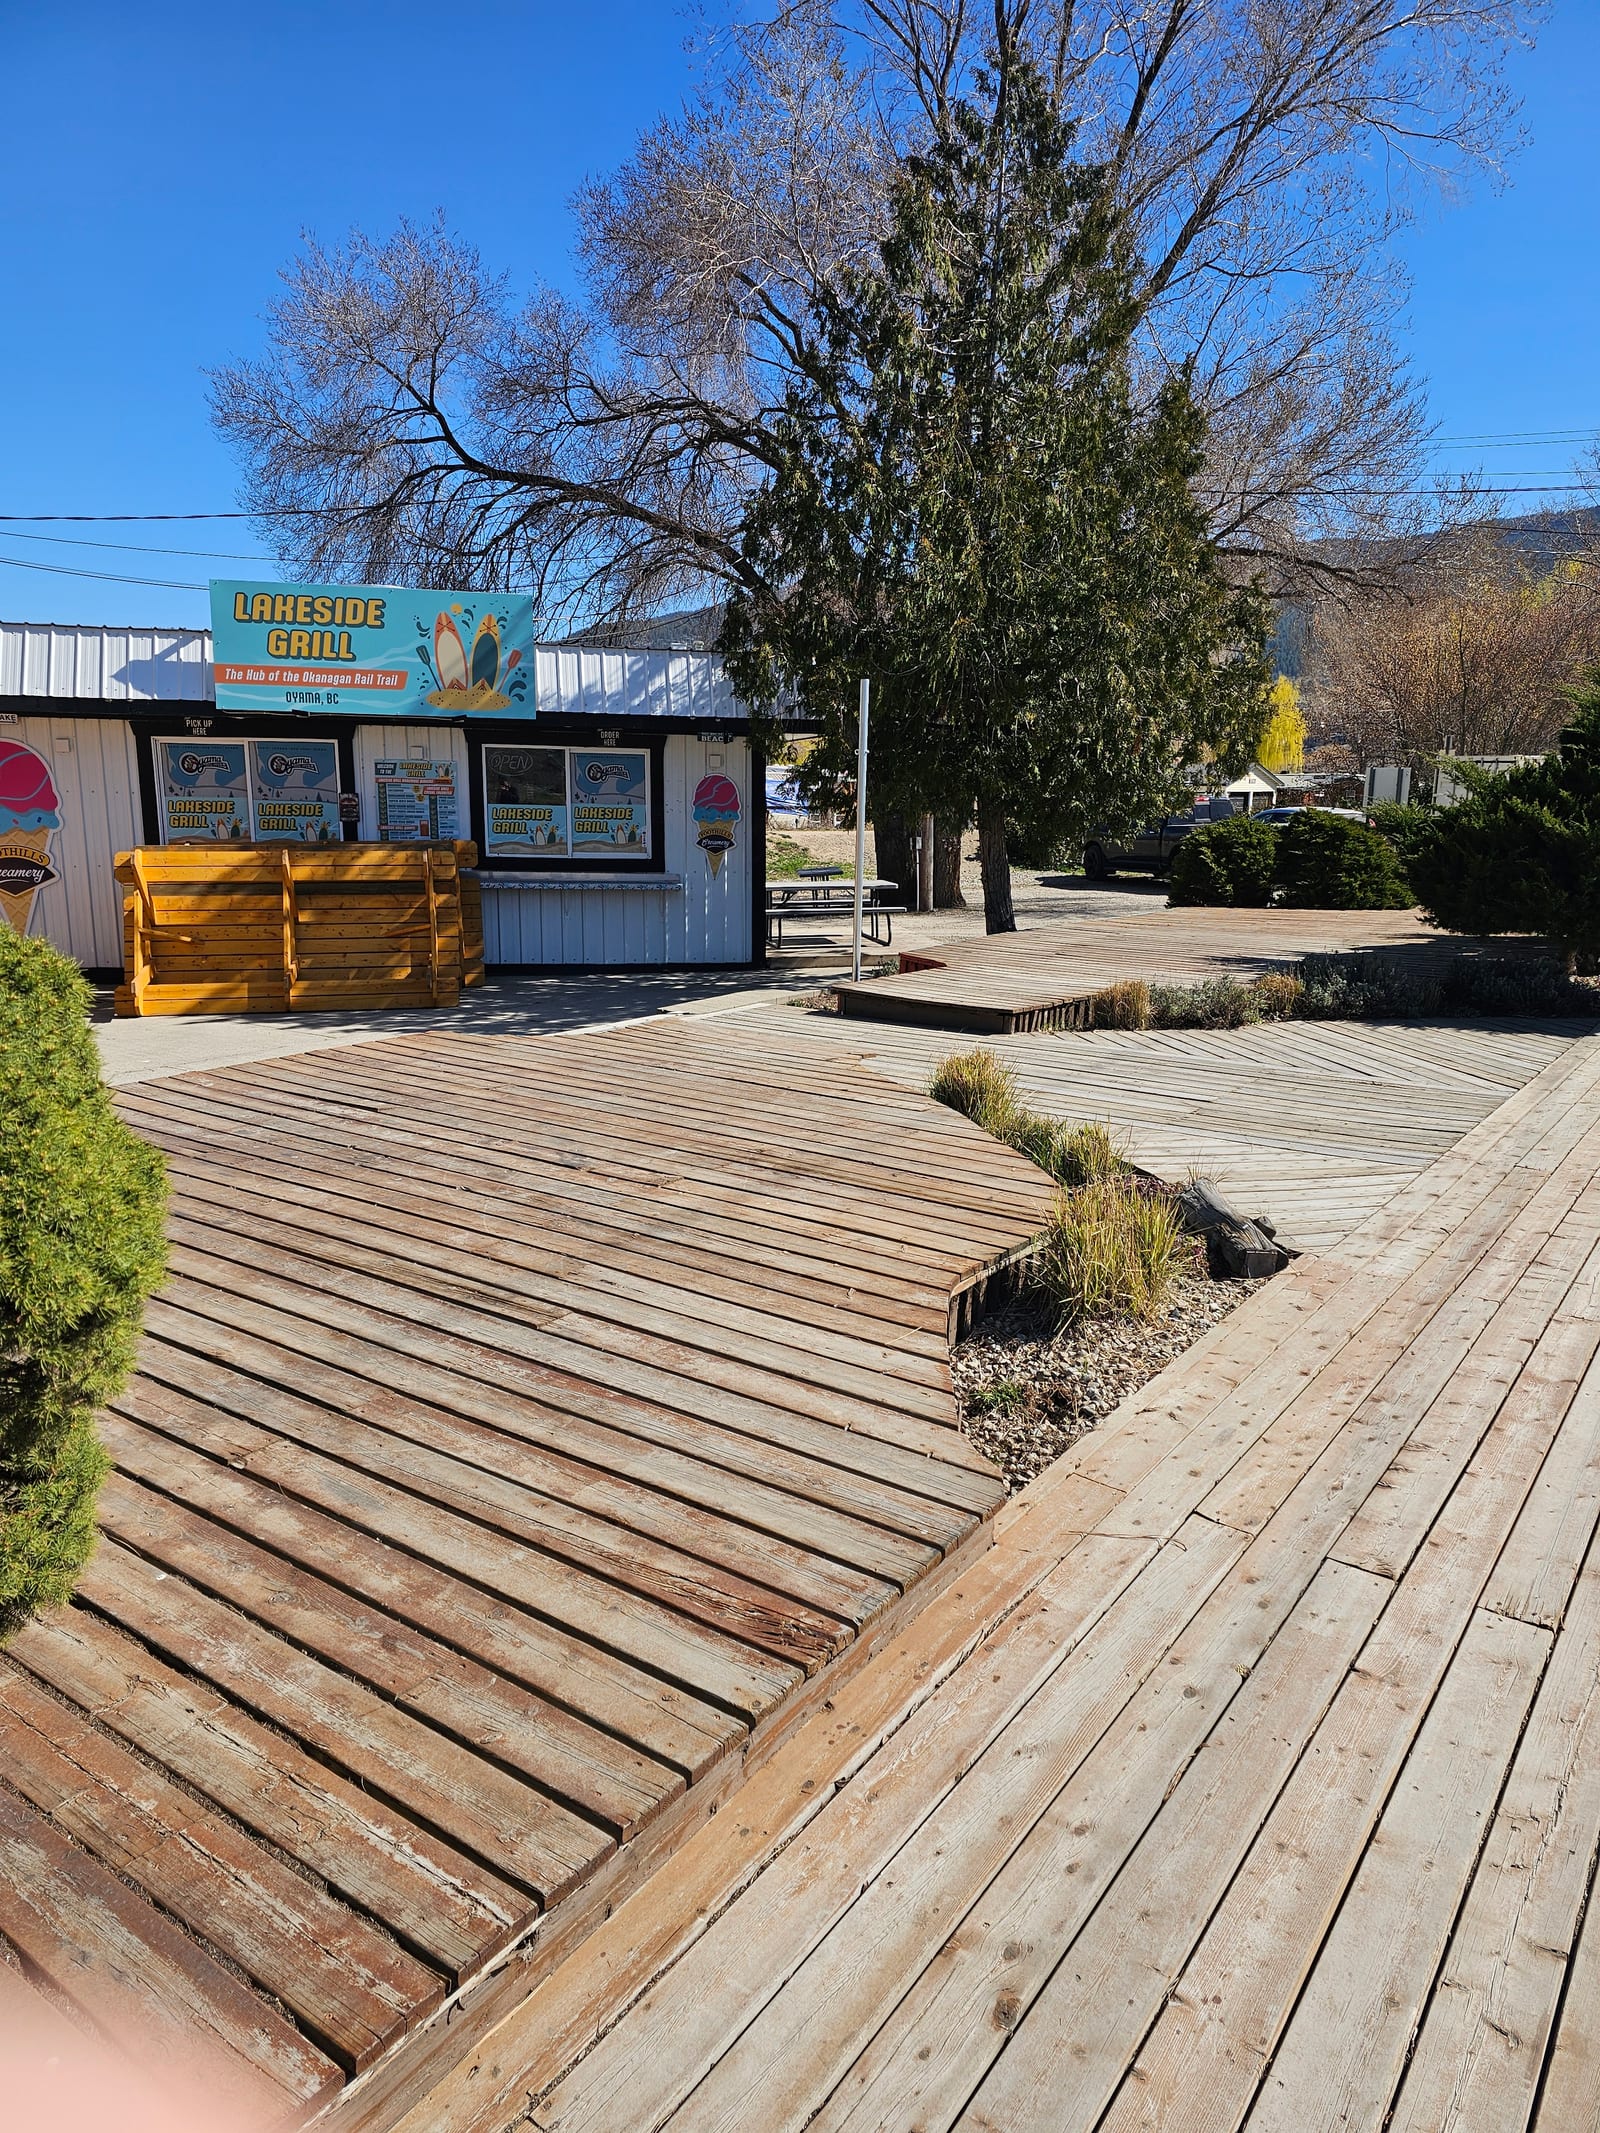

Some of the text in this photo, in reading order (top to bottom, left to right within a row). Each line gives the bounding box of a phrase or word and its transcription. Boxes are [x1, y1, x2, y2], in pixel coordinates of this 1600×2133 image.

[233, 592, 387, 629] LAKESIDE
[267, 628, 357, 662] GRILL
[225, 669, 398, 687] The Hub of the Okanagan Rail Trail
[286, 691, 339, 706] OYAMA, BC
[185, 719, 213, 728] PICK UP
[600, 731, 620, 739] ORDER
[490, 753, 530, 770] OPEN
[168, 800, 235, 814] LAKESIDE
[257, 803, 324, 817] LAKESIDE
[492, 807, 553, 821] LAKESIDE
[573, 807, 634, 820] LAKESIDE
[169, 815, 209, 828] GRILL
[259, 818, 298, 831] GRILL
[492, 821, 529, 835] GRILL
[574, 820, 610, 834] GRILL
